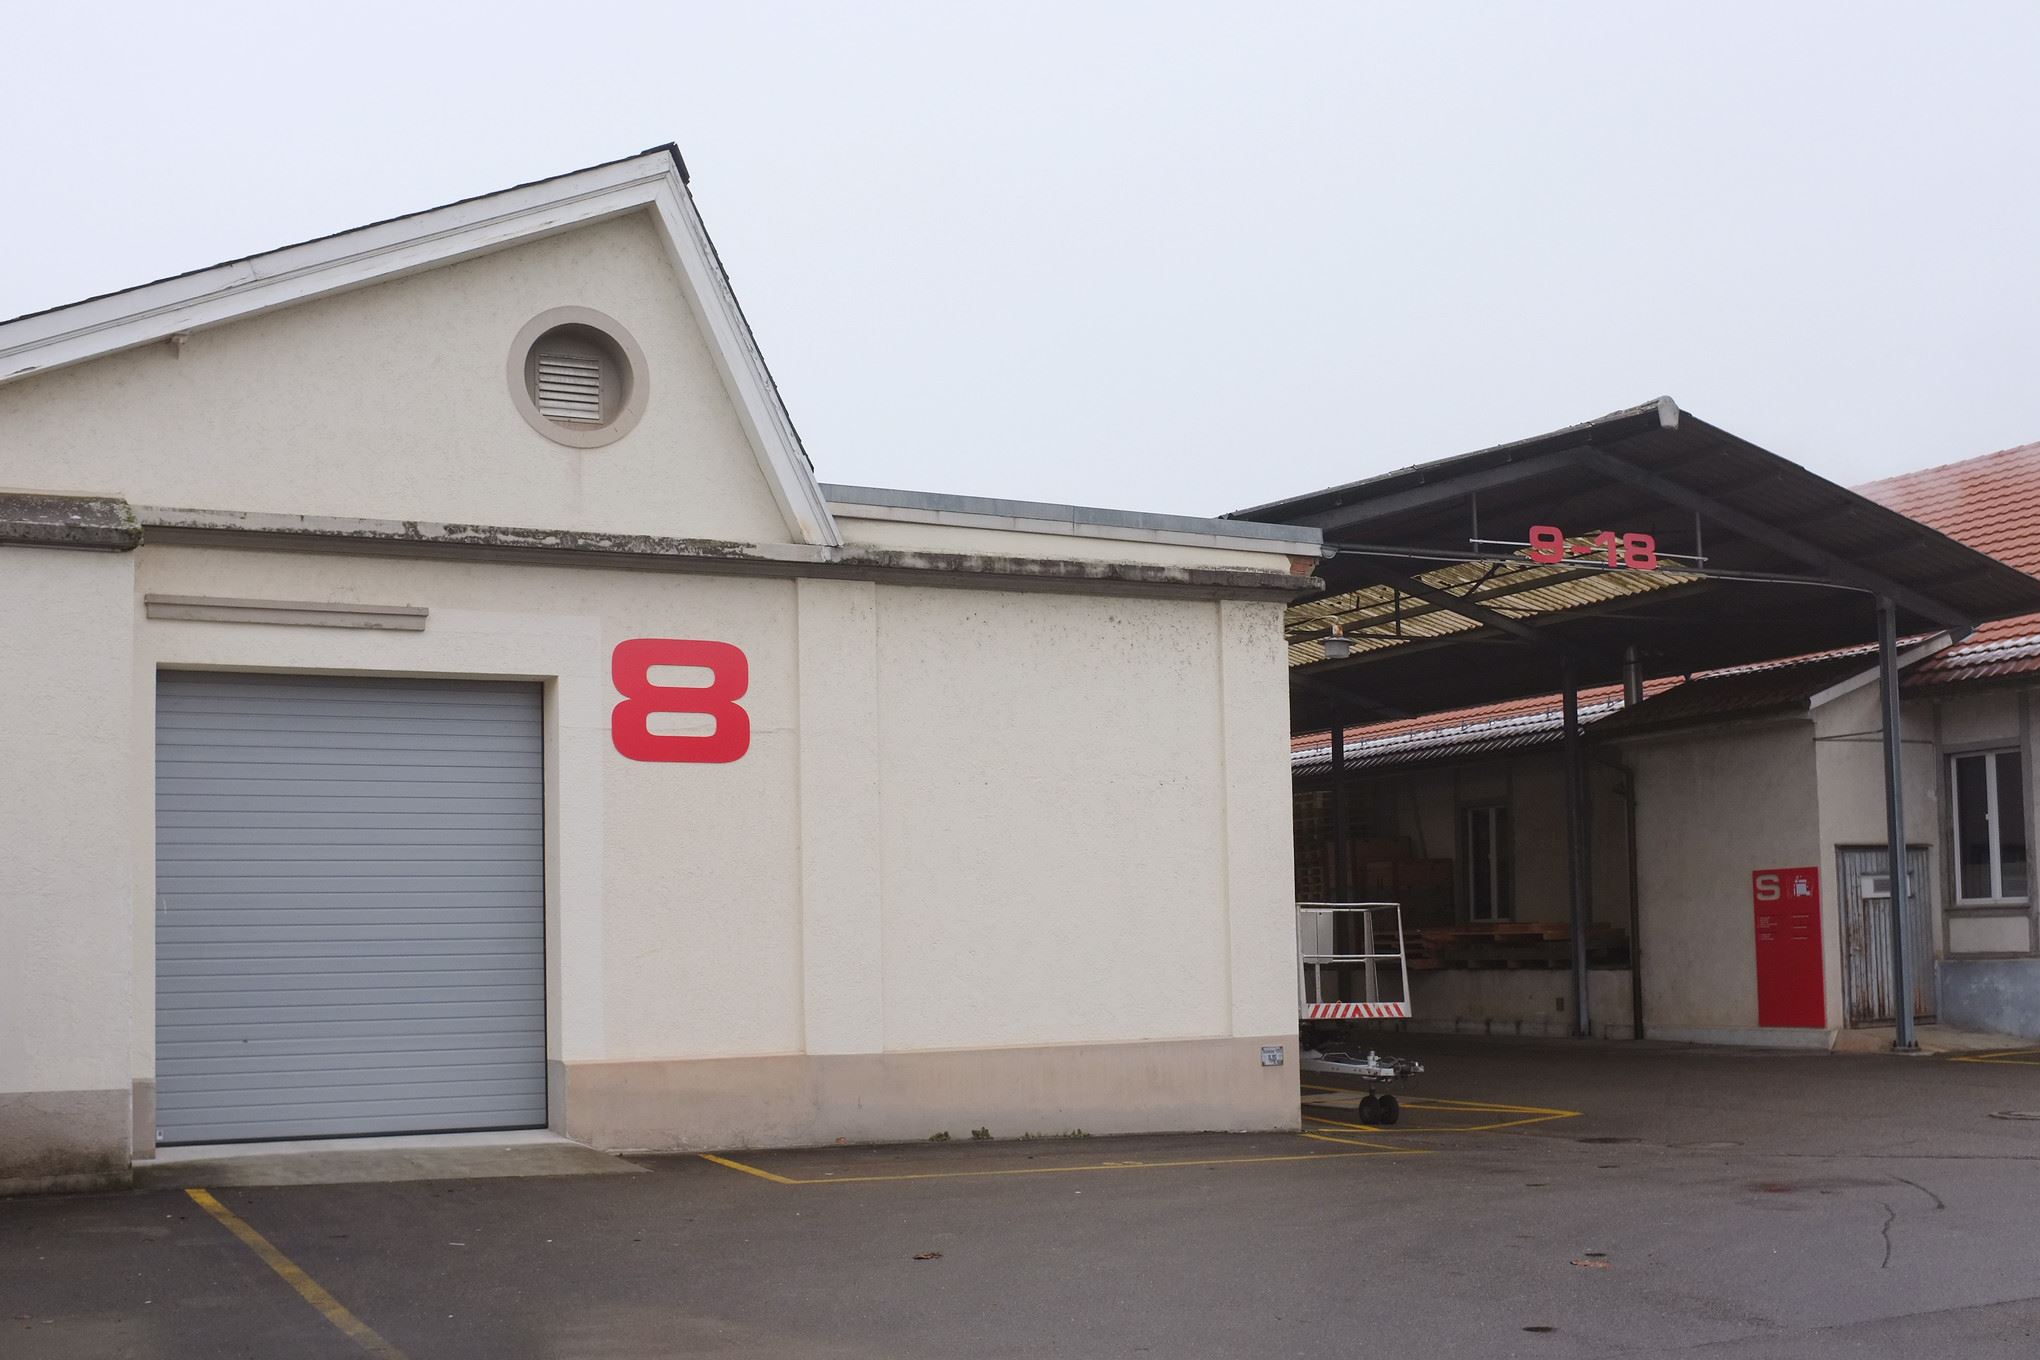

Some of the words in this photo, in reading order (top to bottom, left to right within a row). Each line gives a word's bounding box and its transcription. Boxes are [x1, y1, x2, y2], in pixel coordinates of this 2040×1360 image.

[1529, 525, 1657, 570] 9-18
[611, 638, 750, 763] 8
[1755, 874, 1781, 901] S
